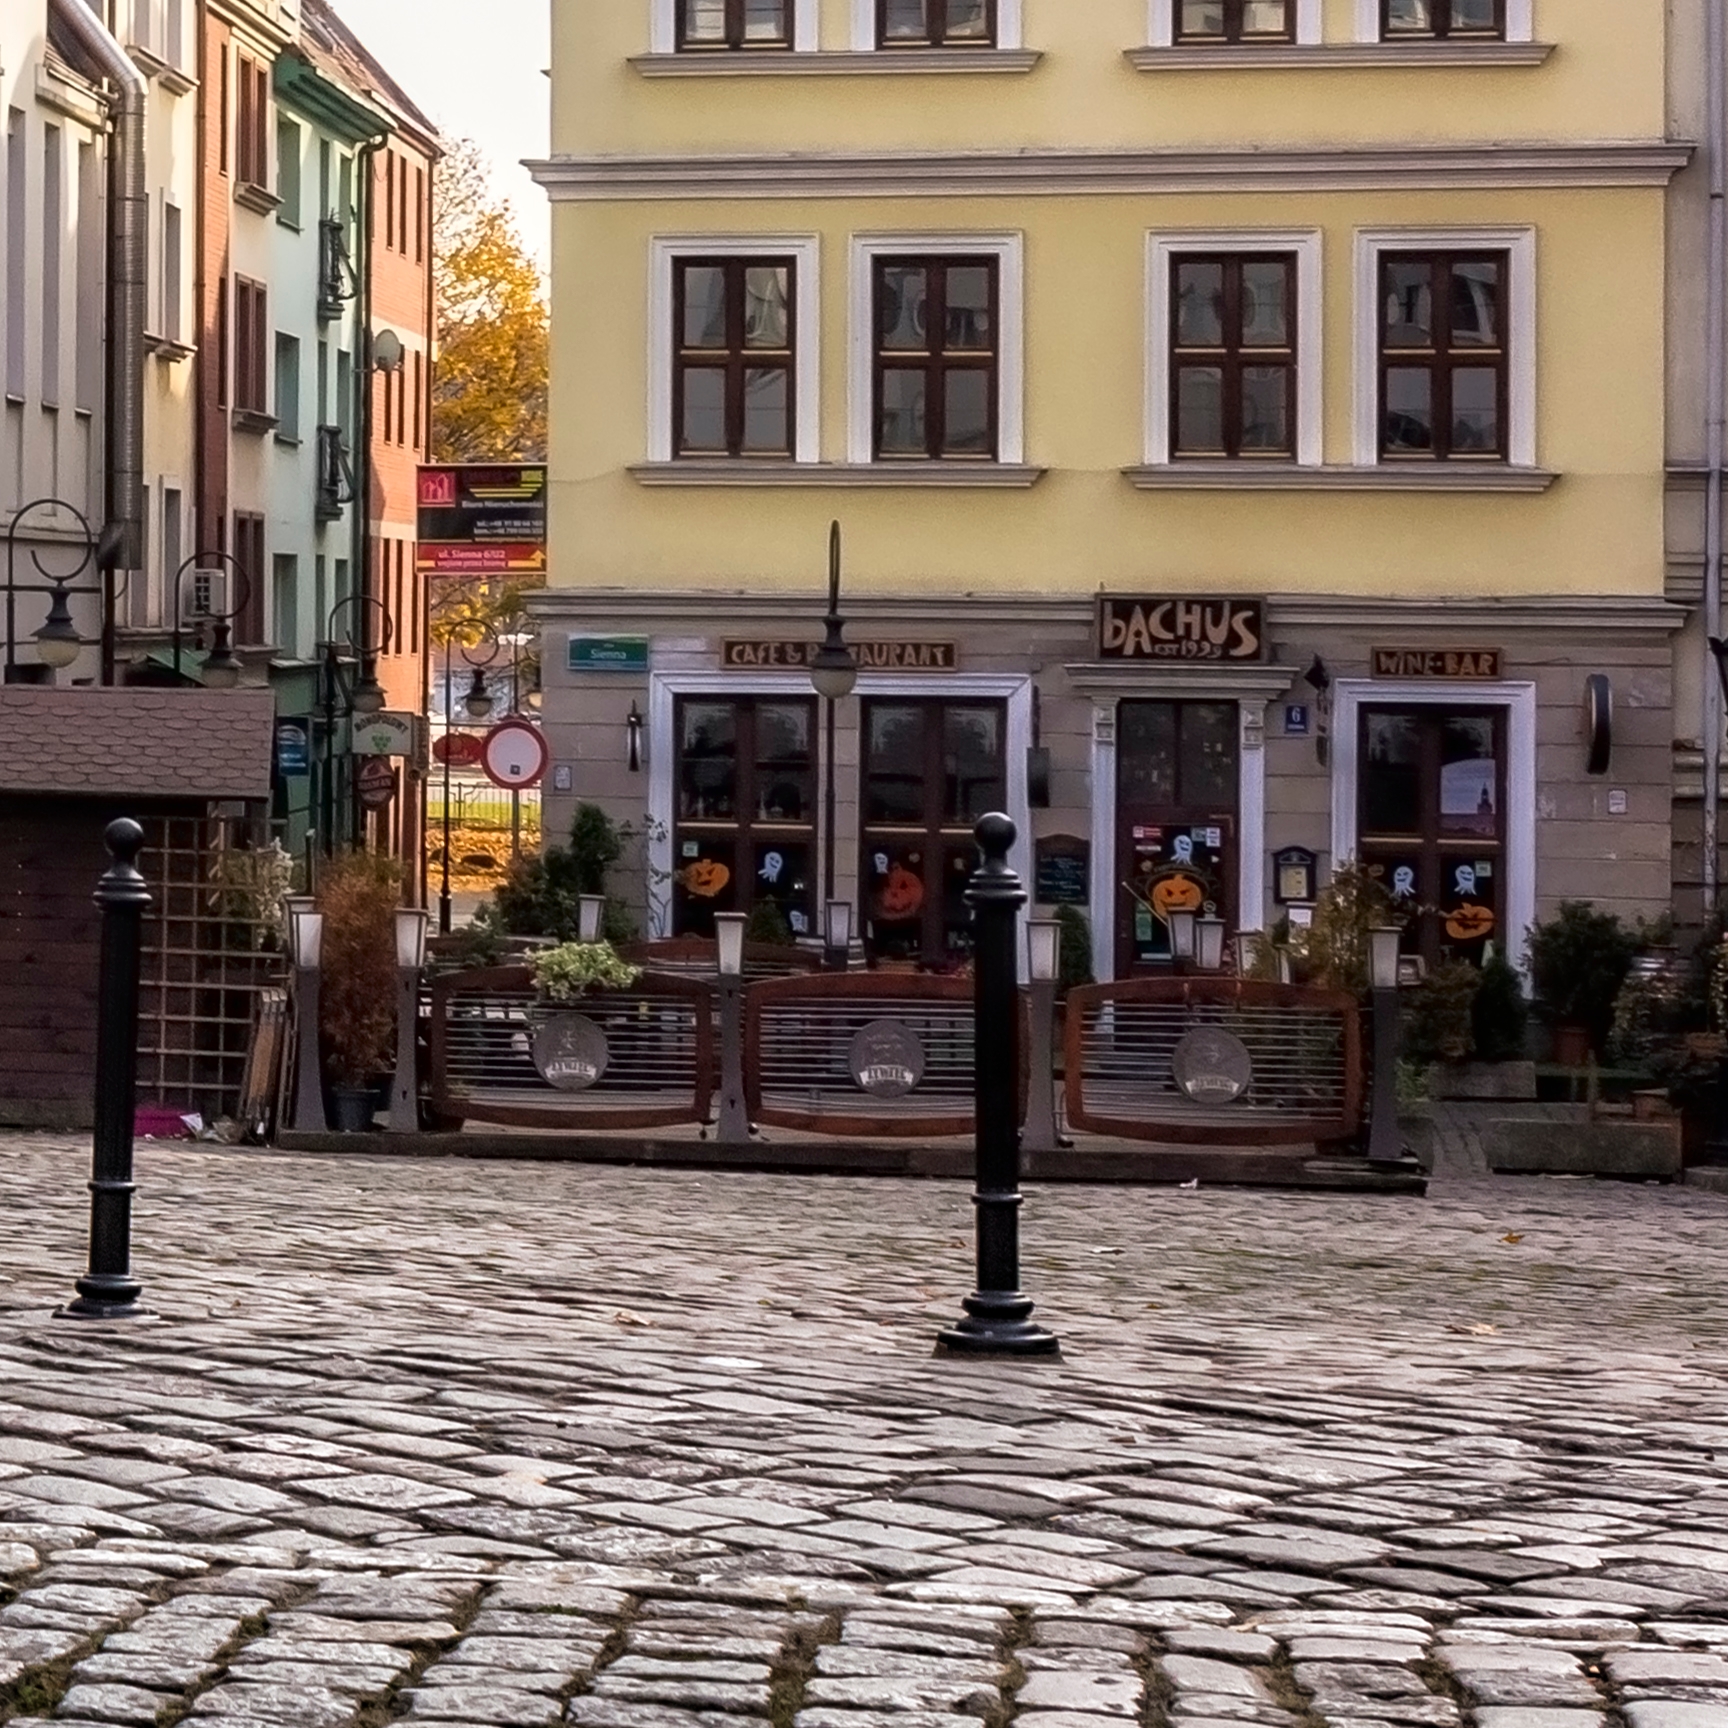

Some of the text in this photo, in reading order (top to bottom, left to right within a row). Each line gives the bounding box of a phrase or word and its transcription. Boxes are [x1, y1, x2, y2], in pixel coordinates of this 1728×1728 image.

[590, 648, 627, 660] Sienna
[731, 643, 946, 667] CAFE & RTAURANT
[1291, 706, 1301, 722] 6
